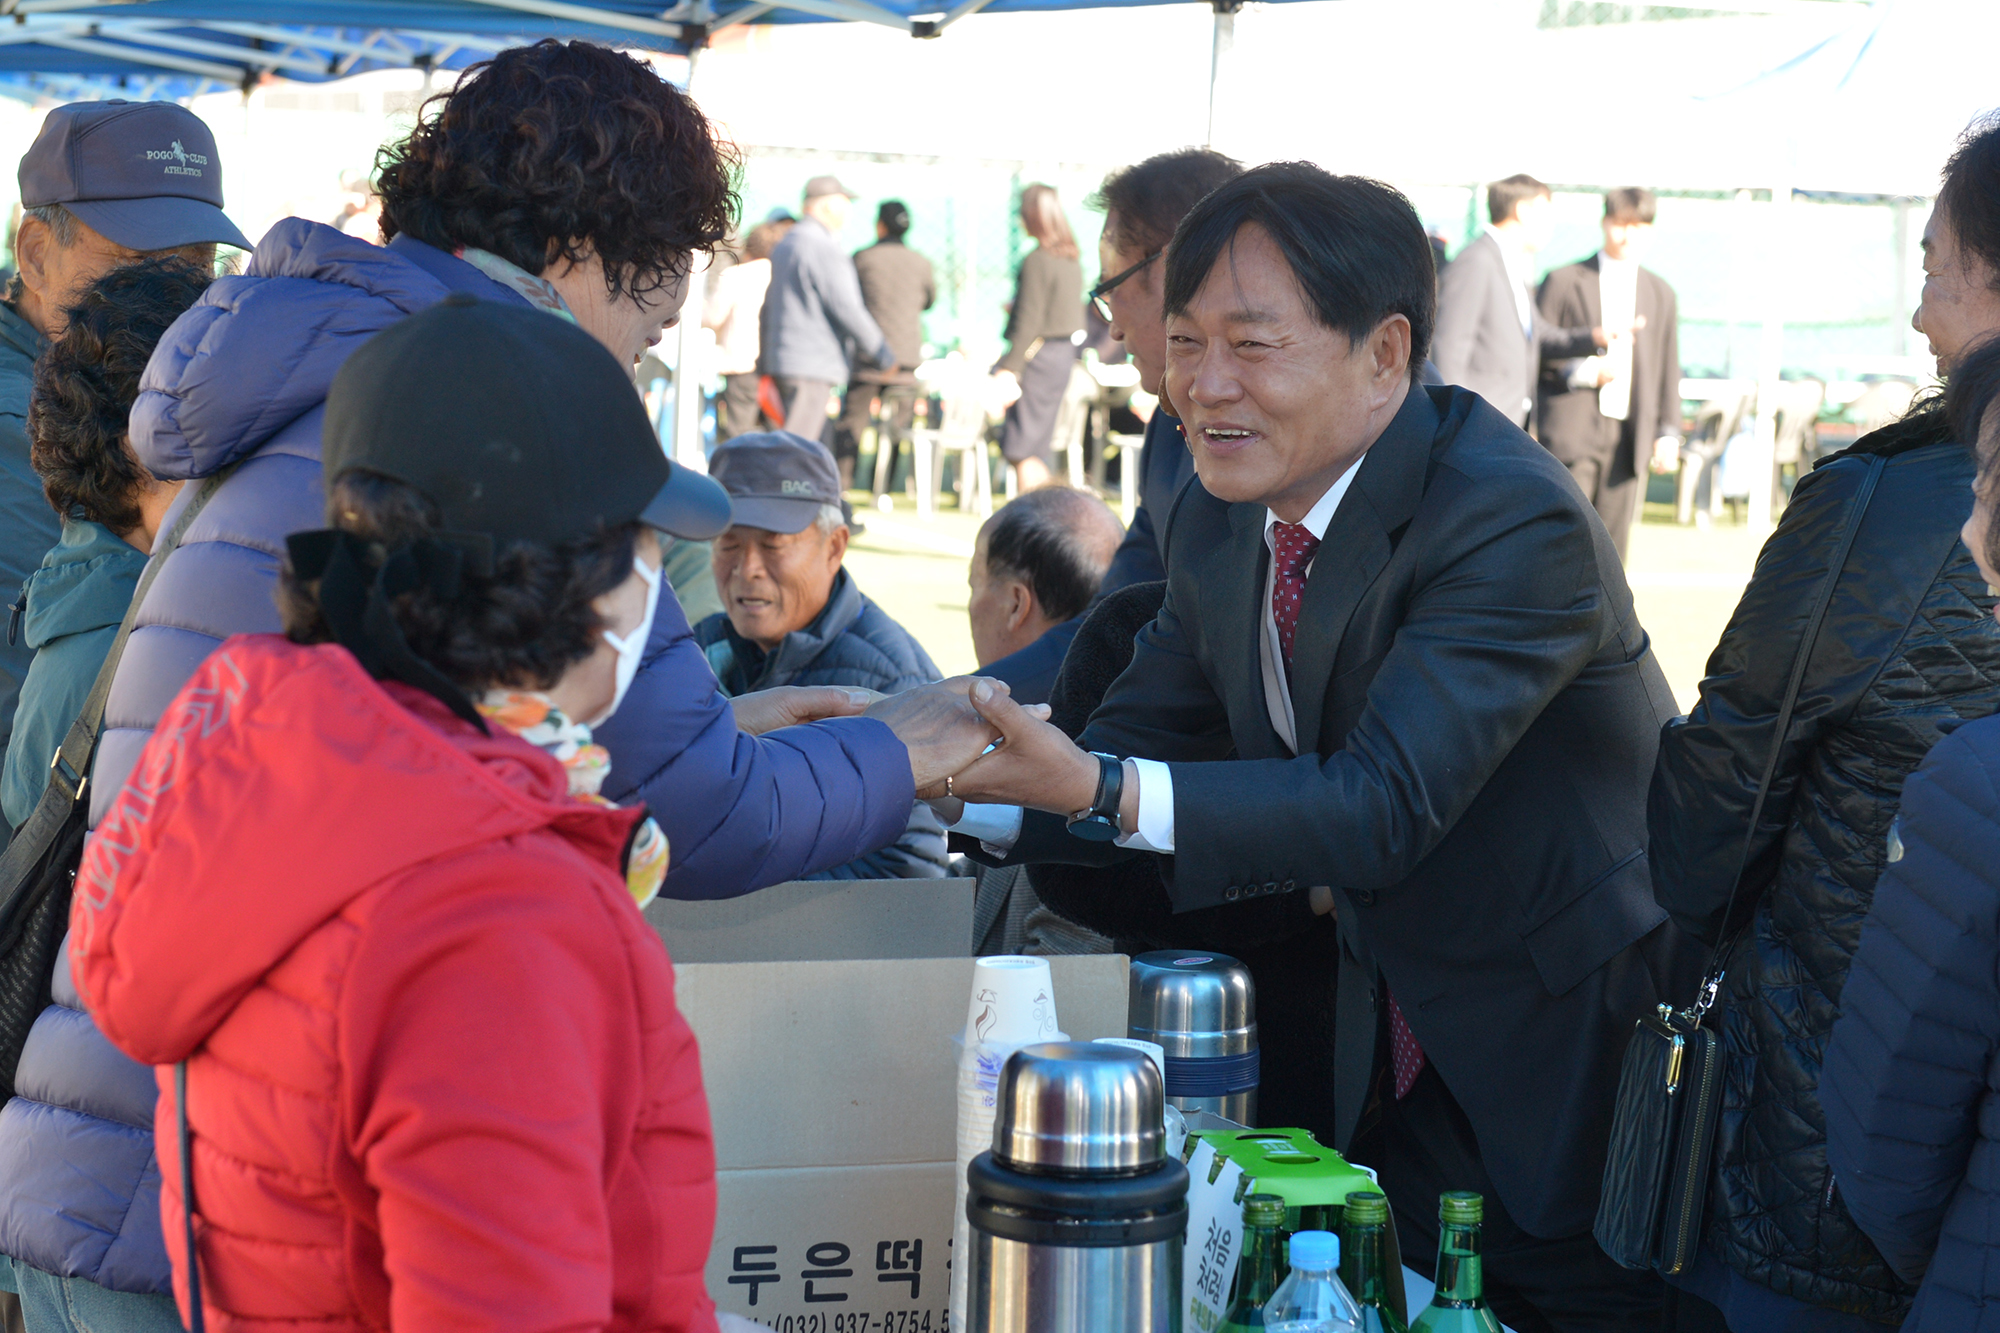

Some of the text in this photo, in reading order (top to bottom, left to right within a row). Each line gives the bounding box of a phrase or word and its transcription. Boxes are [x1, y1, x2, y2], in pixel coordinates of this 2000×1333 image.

[146, 150, 208, 166] POGO CLUB
[164, 165, 203, 178] ATHLETICS
[1204, 1216, 1231, 1268] 처음
[727, 1238, 952, 1306] 두은떡
[1197, 1255, 1224, 1305] 처럼
